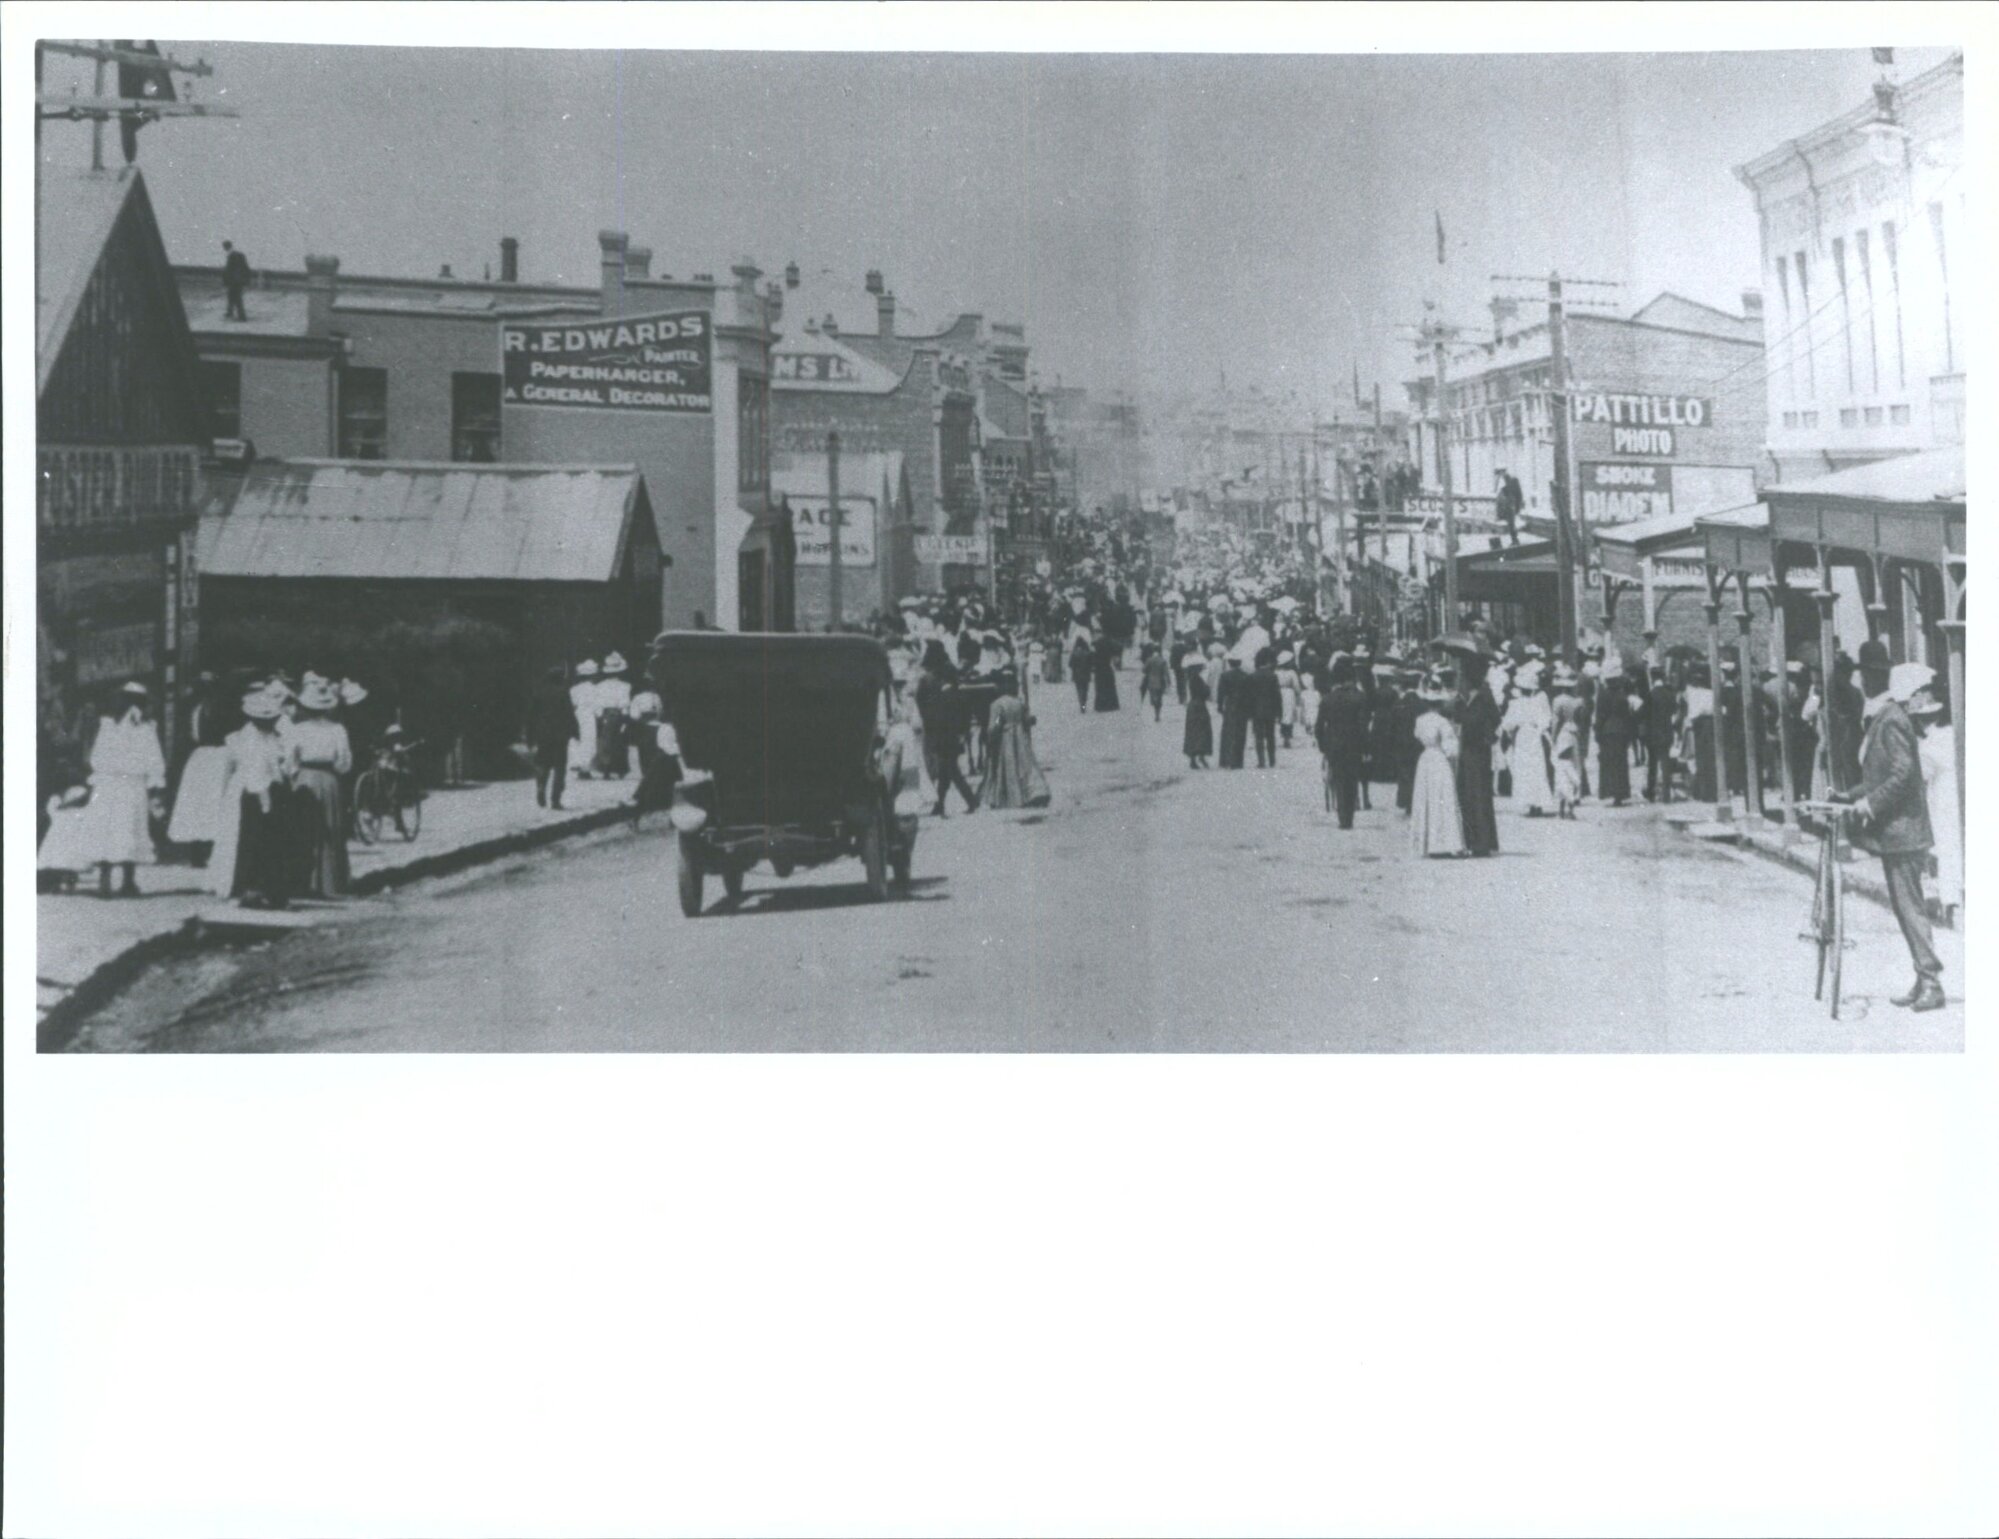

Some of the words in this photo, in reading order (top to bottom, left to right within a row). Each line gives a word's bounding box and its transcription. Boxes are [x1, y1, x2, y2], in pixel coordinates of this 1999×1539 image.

[523, 384, 603, 403] GENERAL
[610, 387, 710, 407] DECORATOR
[1574, 393, 1704, 426] PATTILLO
[1614, 428, 1672, 454] PHOTO
